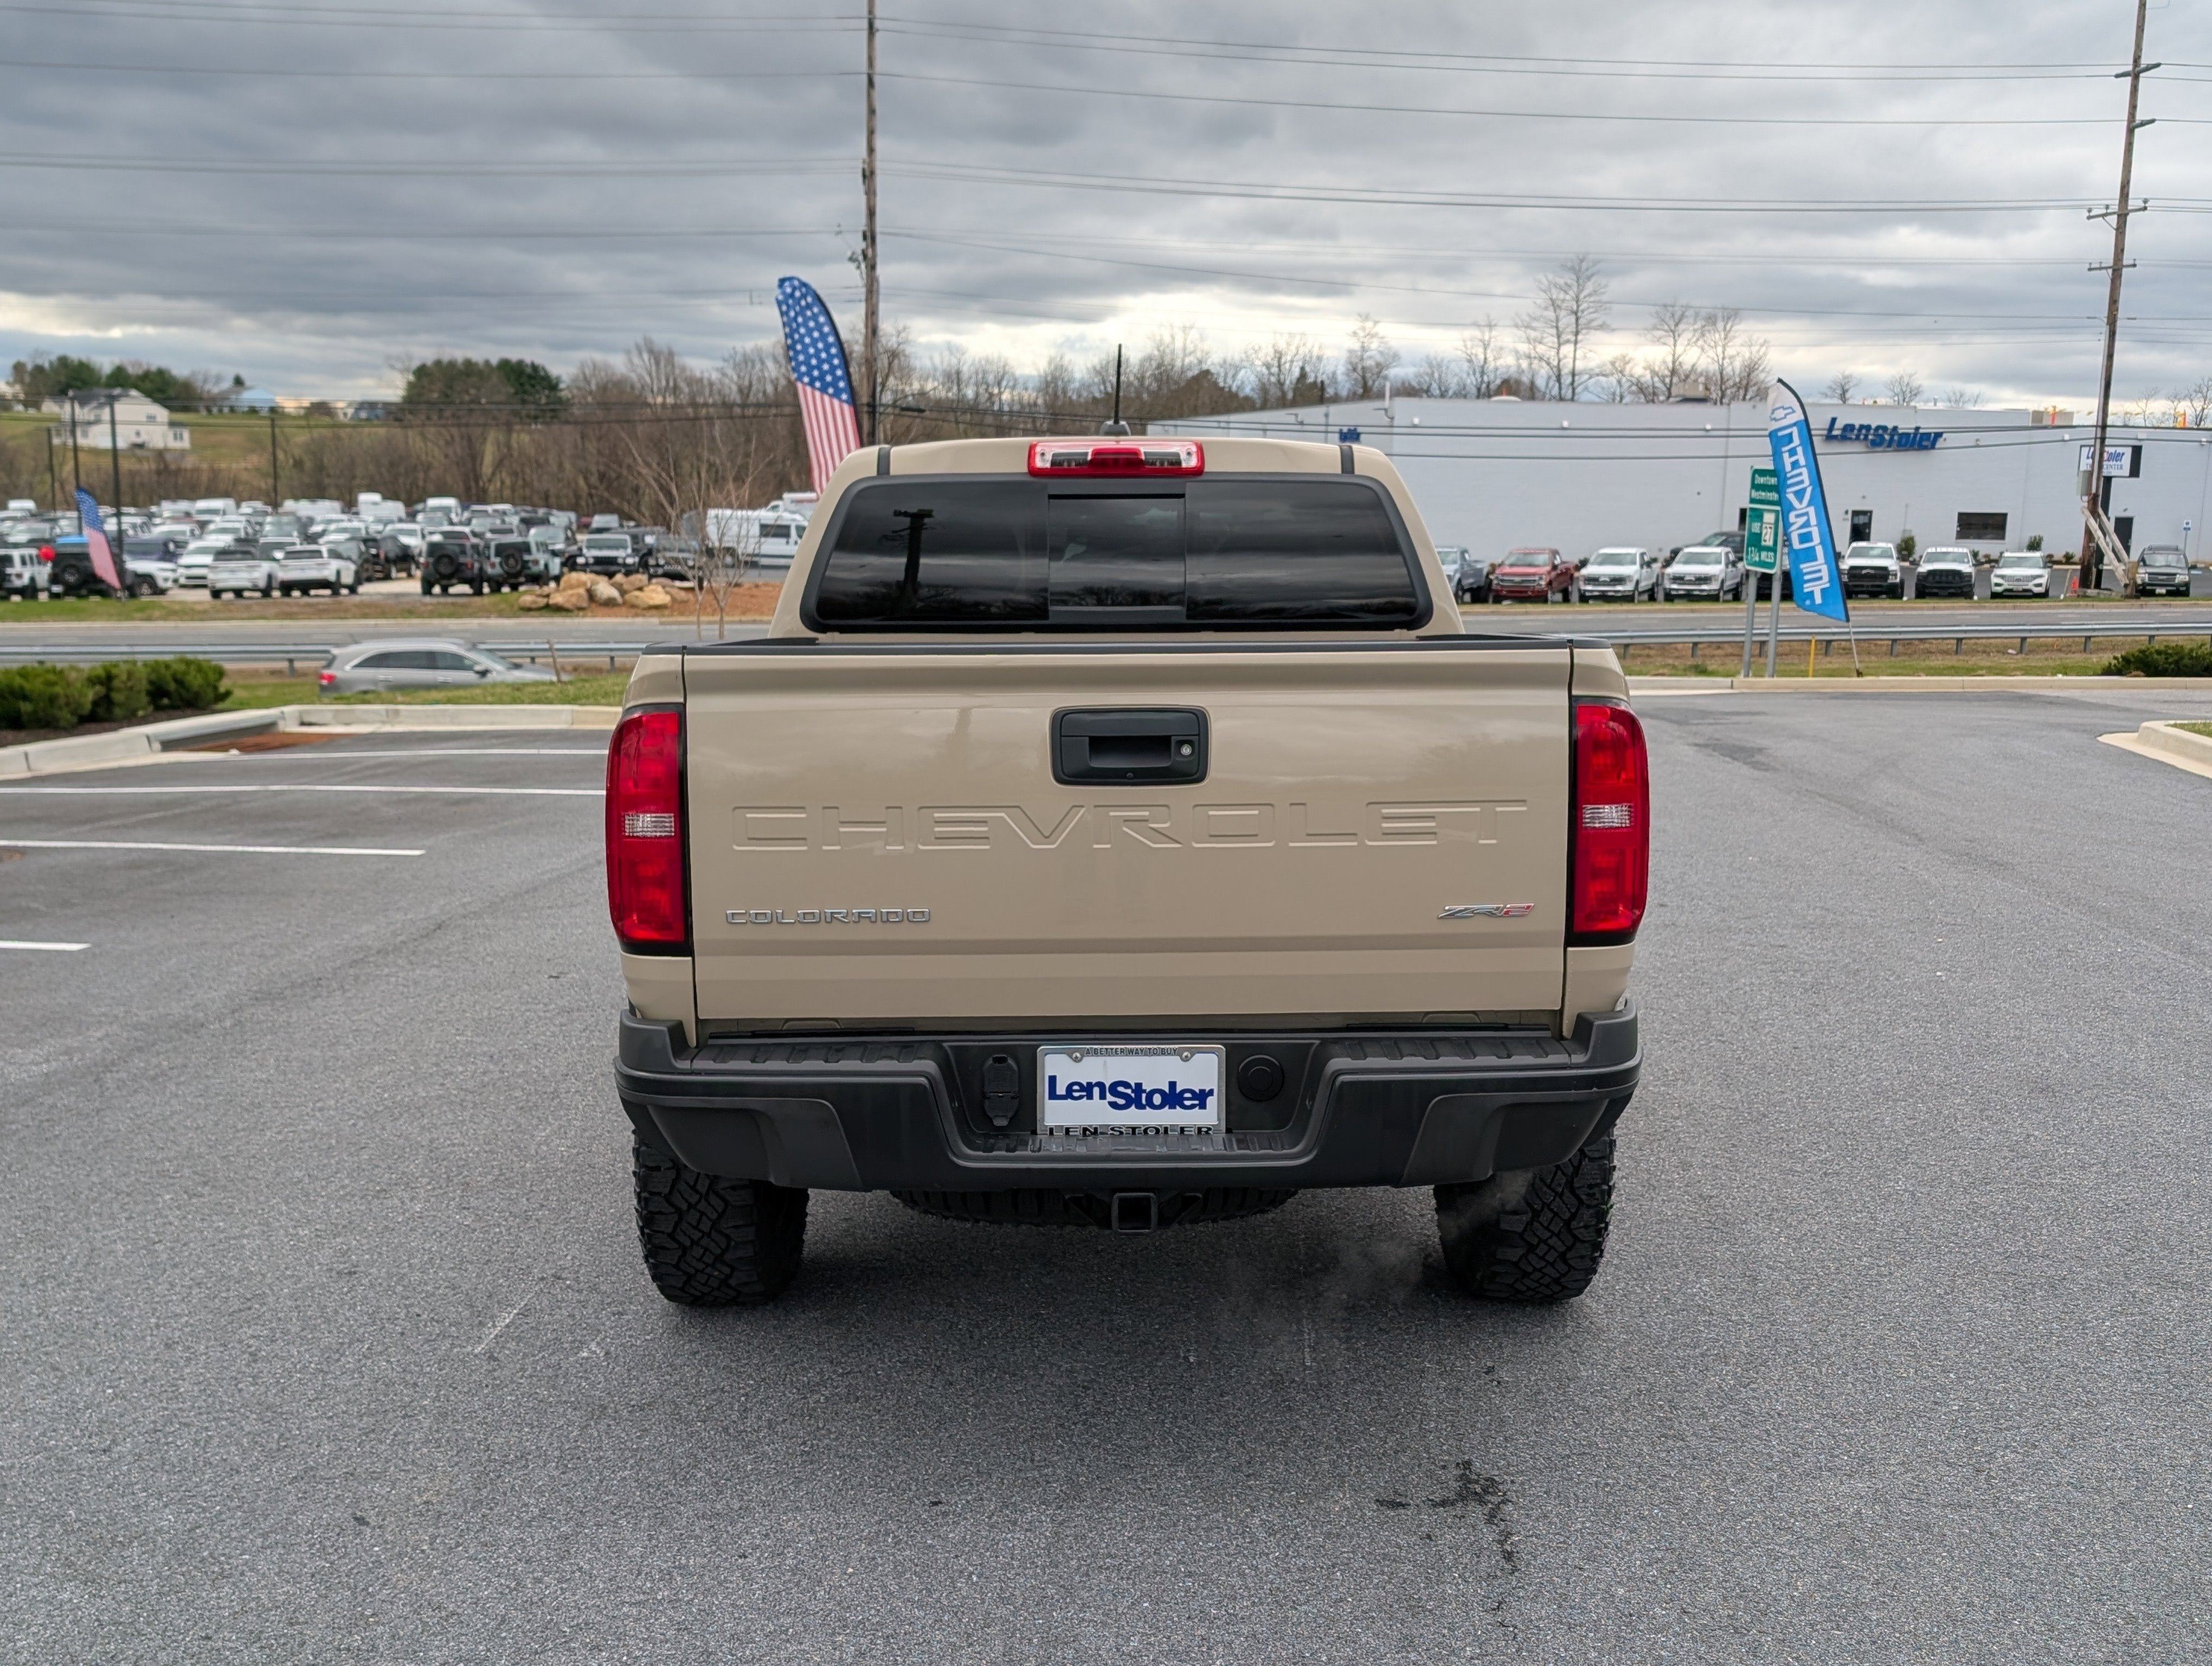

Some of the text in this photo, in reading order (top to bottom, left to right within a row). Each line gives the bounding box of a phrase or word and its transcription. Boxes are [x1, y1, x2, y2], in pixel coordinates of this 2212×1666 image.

[1824, 416, 1944, 450] LenStoler
[1754, 474, 1778, 485] Downtown
[1778, 426, 1830, 605] CHEVROLET
[1752, 522, 1773, 543] USE 27
[1761, 550, 1774, 563] MILES
[732, 800, 1528, 850] CHEVROLET
[725, 908, 931, 924] COLORADO
[1438, 903, 1534, 919] ZR2
[1094, 1047, 1126, 1056] BETTER
[1128, 1047, 1146, 1056] WAY
[1148, 1047, 1160, 1055] TO
[1161, 1047, 1178, 1056] BUY
[1048, 1075, 1214, 1110] LenStoler
[1047, 1125, 1213, 1136] LEN STOLER
